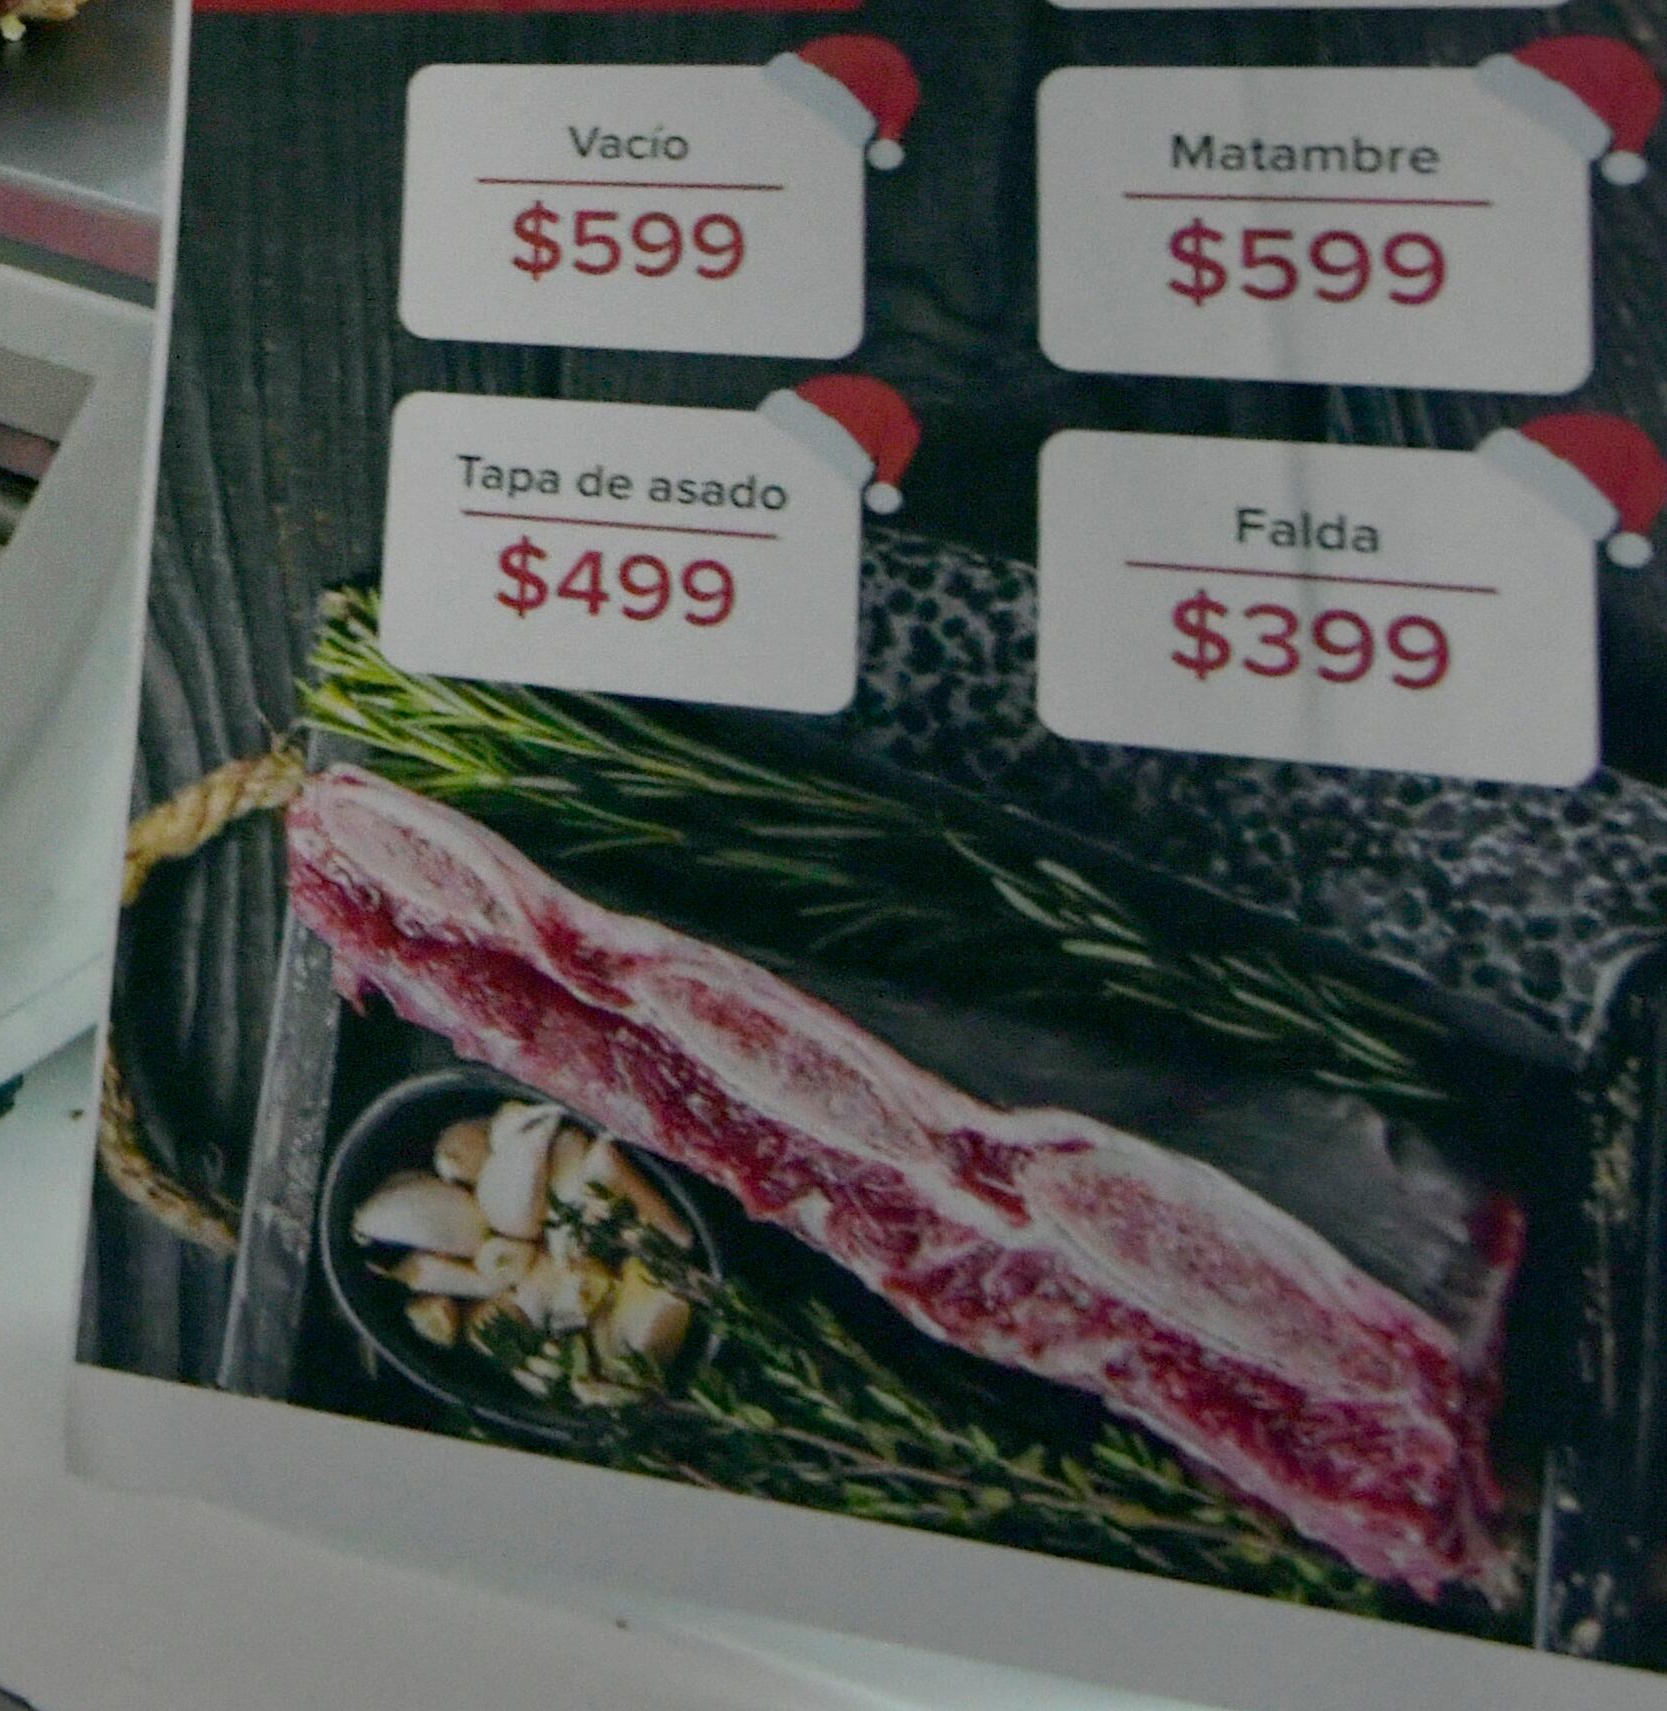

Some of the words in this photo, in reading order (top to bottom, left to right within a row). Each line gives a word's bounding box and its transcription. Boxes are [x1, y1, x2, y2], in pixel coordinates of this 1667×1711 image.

[567, 125, 690, 161] Vacío
[1169, 133, 1441, 175] Matambre
[511, 200, 747, 282] $599
[1166, 217, 1448, 307] $599
[456, 453, 562, 498] Tapa
[574, 465, 635, 502] de
[648, 474, 789, 512] asado
[1234, 506, 1382, 555] Falda
[495, 534, 737, 627] $499
[1169, 587, 1451, 691] $399
